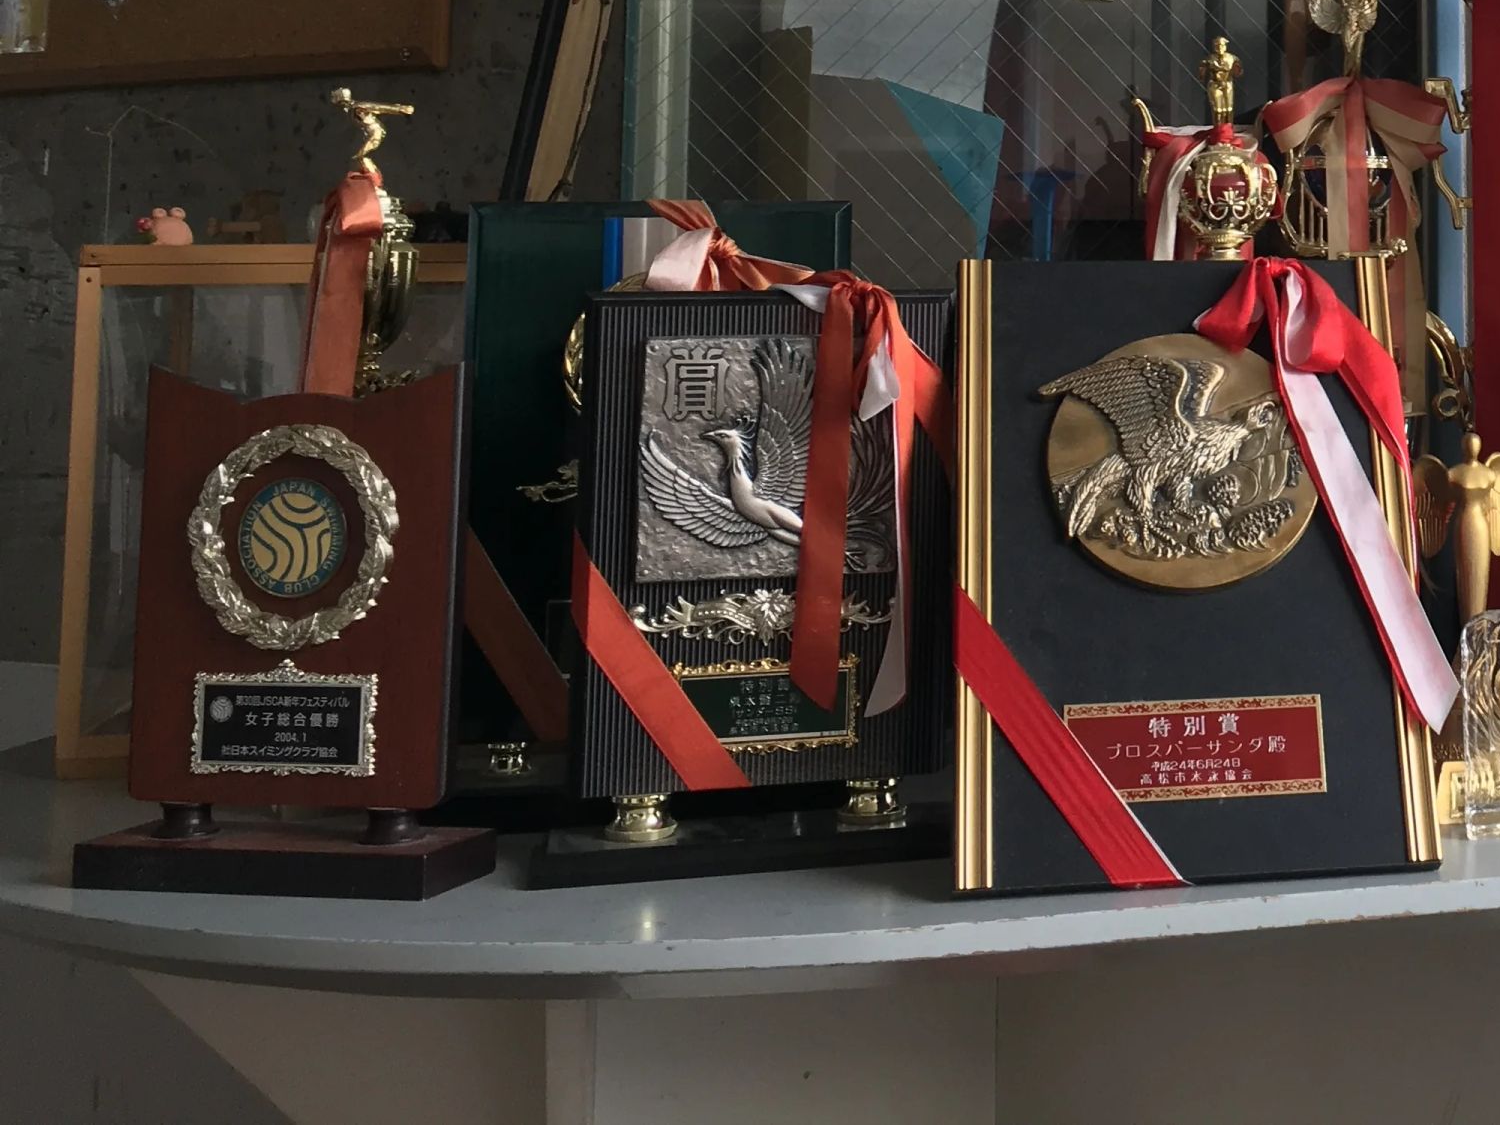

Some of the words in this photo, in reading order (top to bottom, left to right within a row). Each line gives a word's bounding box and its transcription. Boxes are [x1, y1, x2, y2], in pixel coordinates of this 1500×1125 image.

[272, 481, 316, 497] JAPAN
[283, 575, 320, 594] CLUB
[245, 711, 339, 728] 女子総合優勝
[1148, 713, 1241, 738] 特別賞
[1151, 757, 1241, 772] 平成24年6月24日
[1140, 768, 1254, 786] 高松市水泳協会
